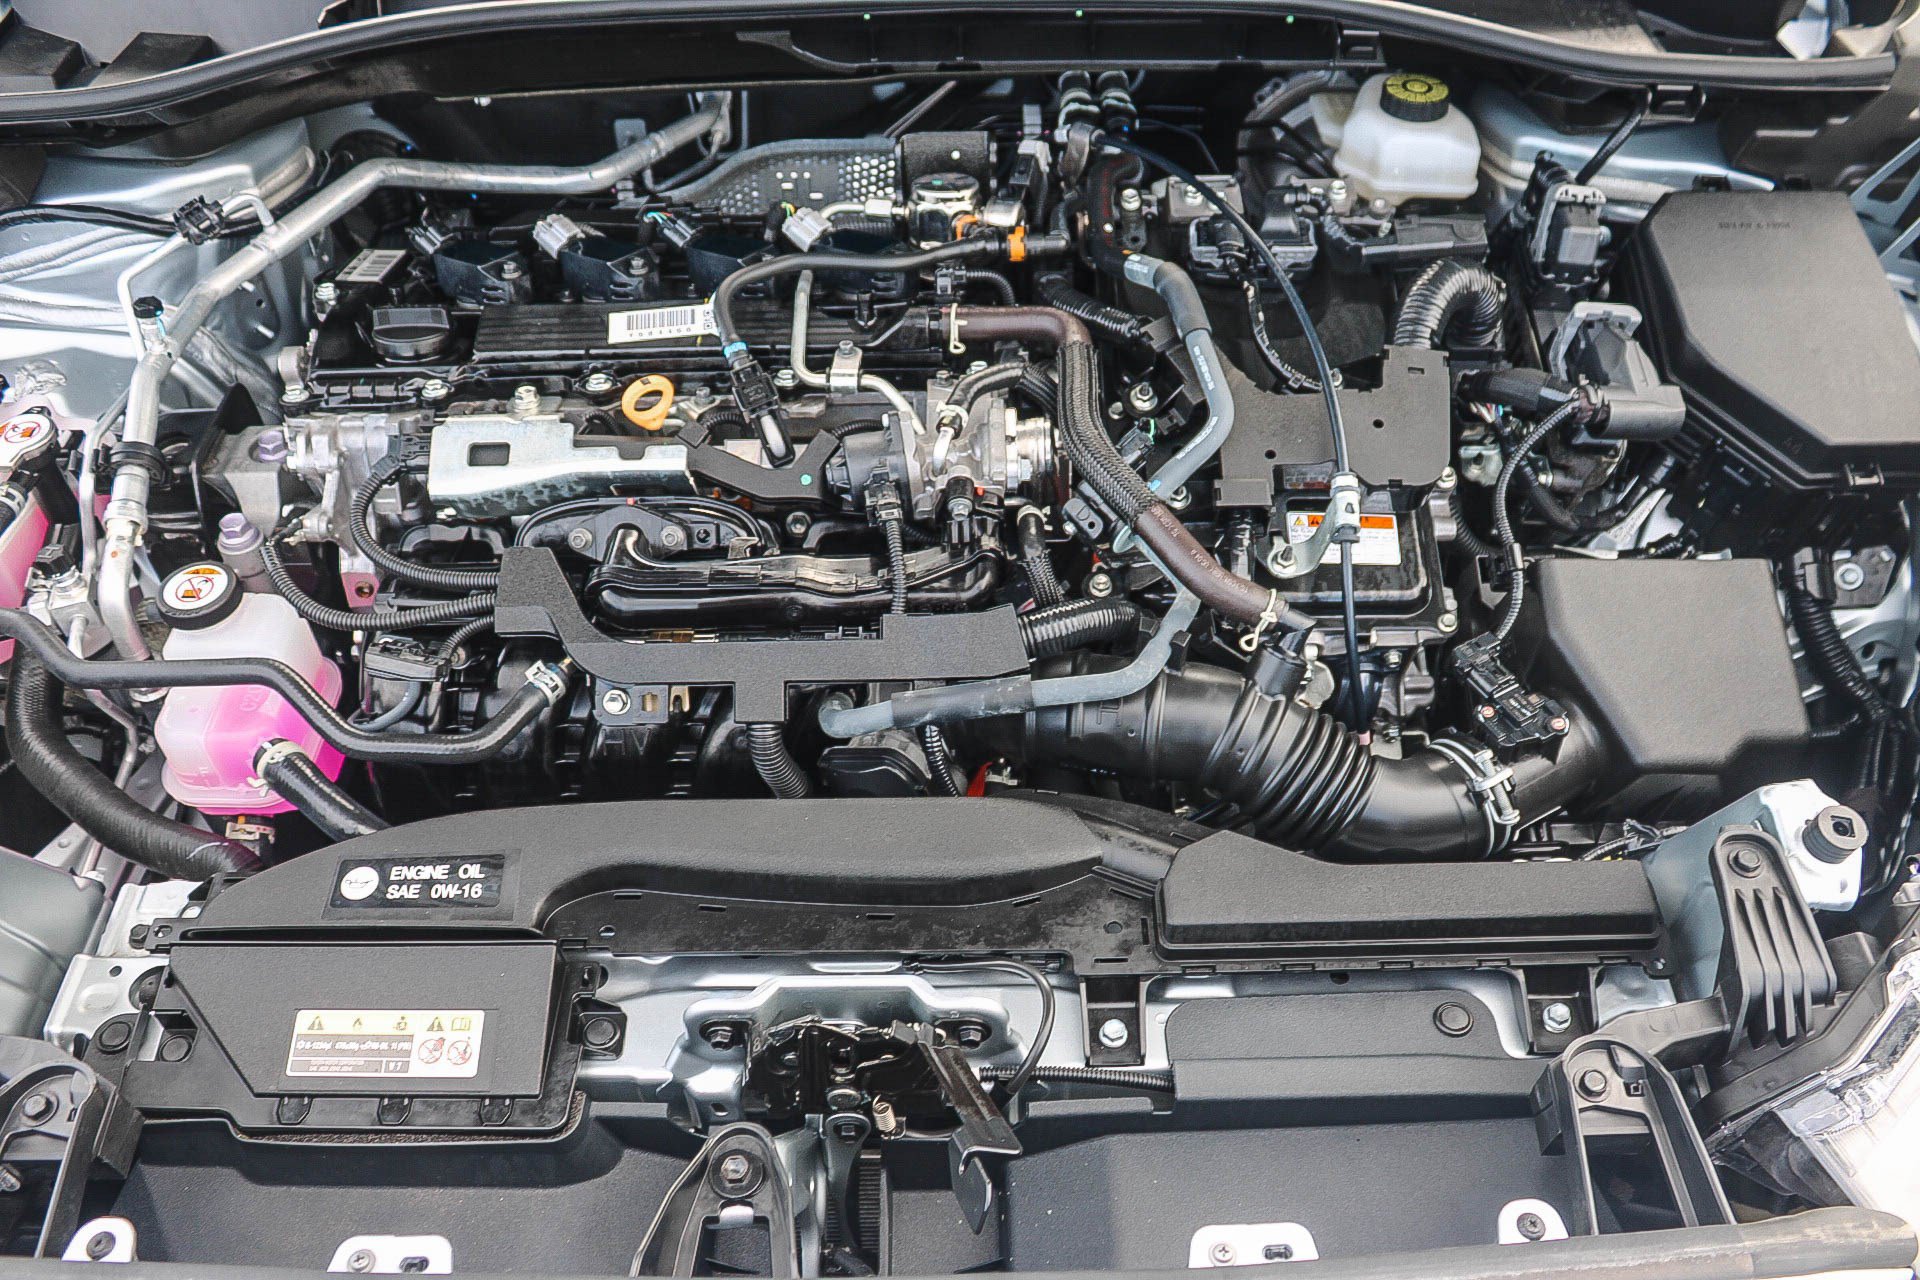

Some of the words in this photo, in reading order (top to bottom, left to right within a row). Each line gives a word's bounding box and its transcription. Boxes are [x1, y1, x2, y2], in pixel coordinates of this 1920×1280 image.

[389, 864, 451, 881] ENGINE
[458, 863, 486, 880] OIL
[386, 884, 422, 900] SAE
[430, 883, 483, 899] 0W-16
